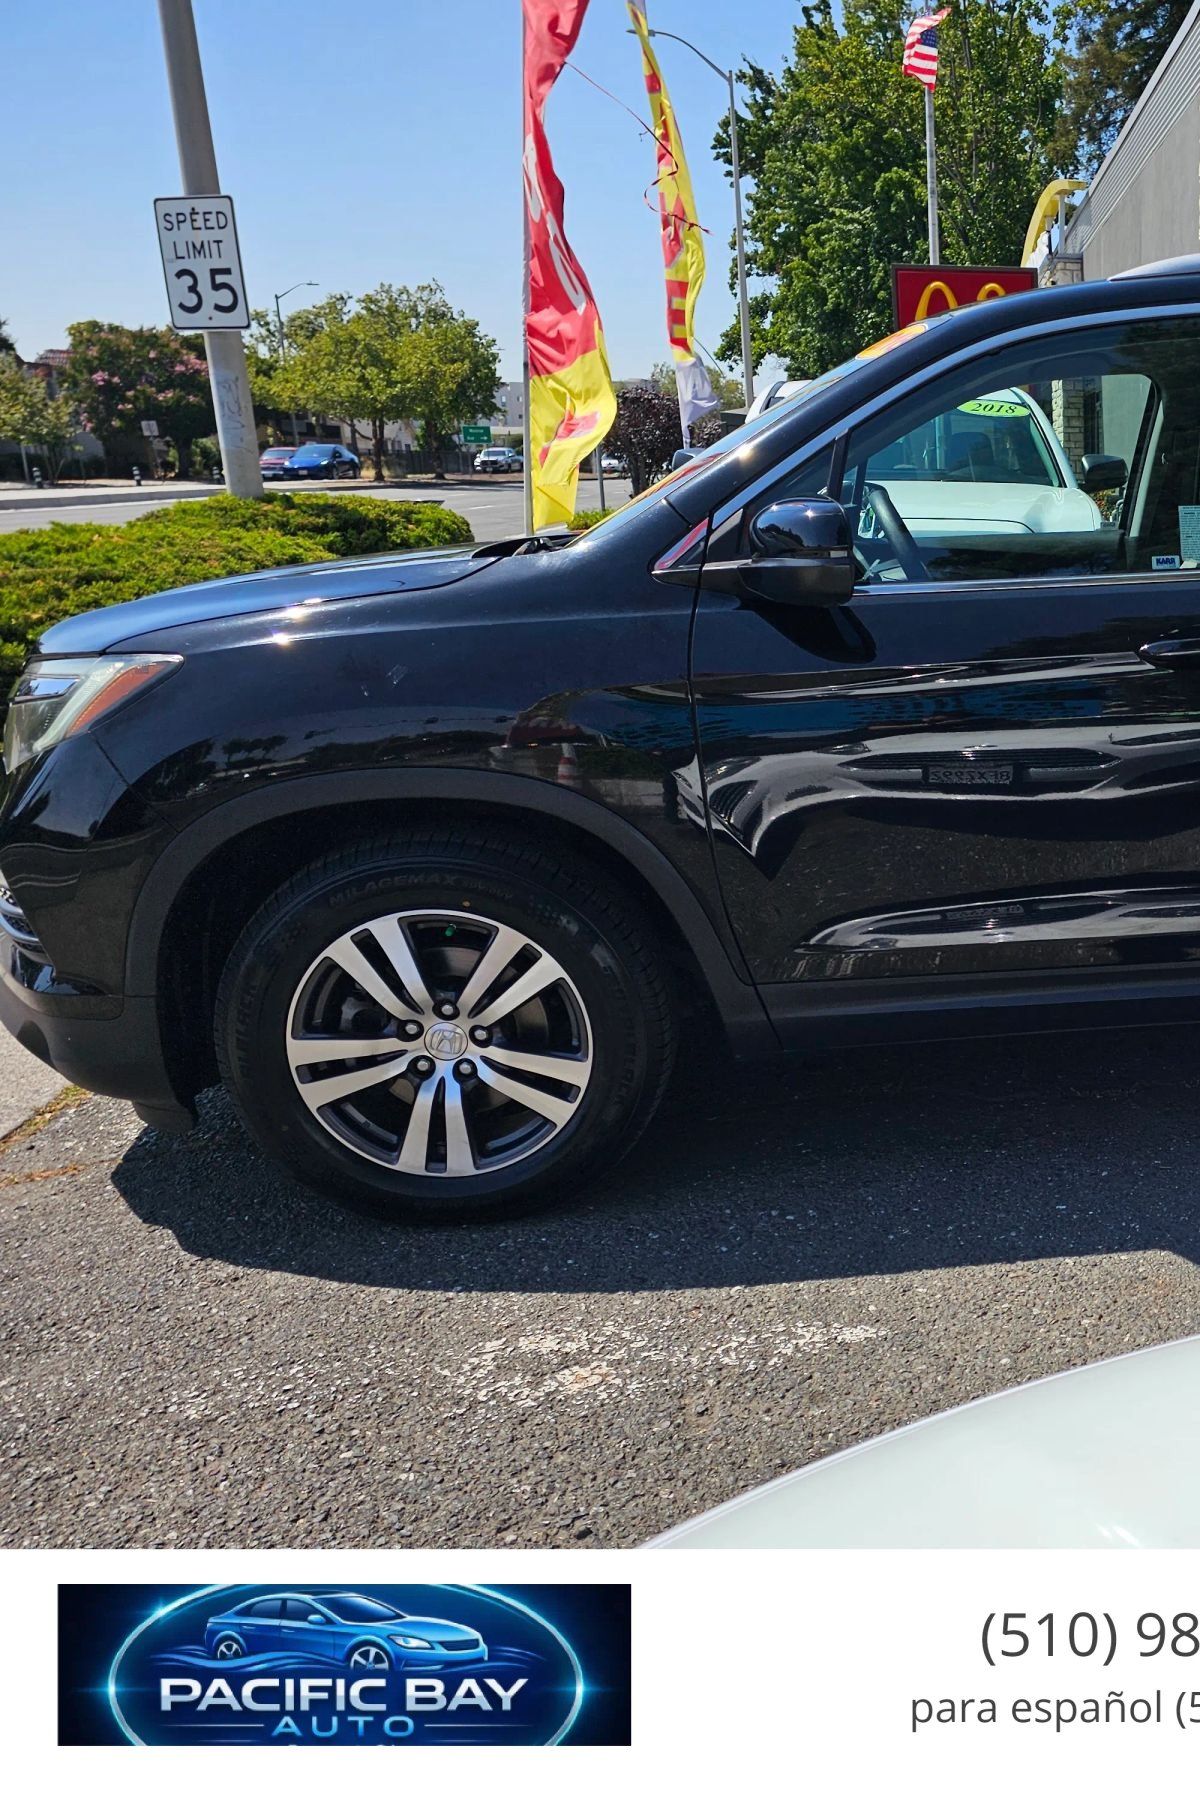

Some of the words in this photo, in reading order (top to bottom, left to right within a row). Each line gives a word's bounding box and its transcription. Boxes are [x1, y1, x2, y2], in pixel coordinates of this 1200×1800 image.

[163, 211, 229, 232] SPEED
[173, 240, 223, 260] LIMIT
[174, 267, 239, 315] 35
[971, 402, 1018, 415] 2018
